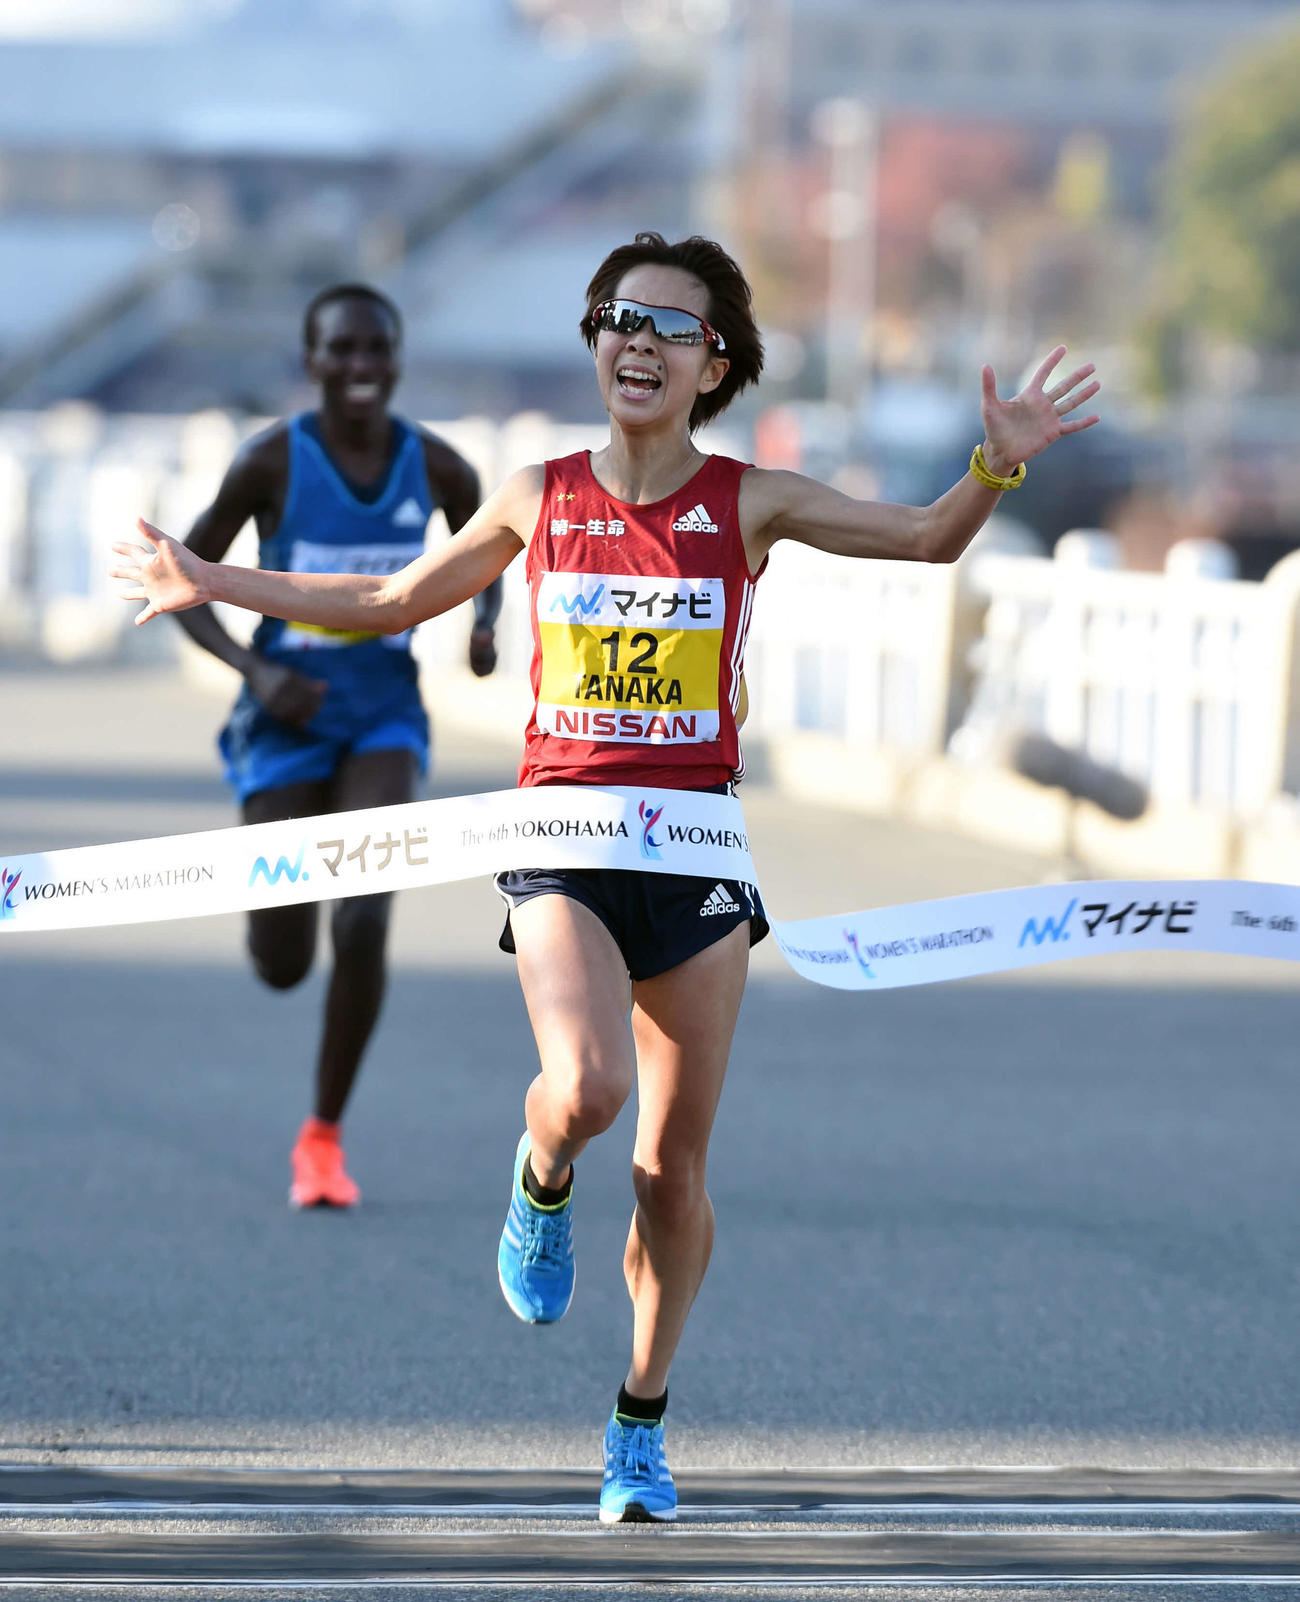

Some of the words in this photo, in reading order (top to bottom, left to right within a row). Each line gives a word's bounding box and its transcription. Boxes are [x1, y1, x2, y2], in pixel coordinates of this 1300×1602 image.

[550, 519, 626, 537] 第一生命
[672, 519, 719, 534] adidas
[611, 589, 712, 619] マイナビ
[600, 631, 659, 675] 12
[555, 710, 697, 739] NISSAN
[461, 829, 484, 848] The
[514, 820, 630, 839] YOKOHAMA
[667, 824, 749, 853] WOMEN'S
[316, 826, 429, 877] マイナビ
[24, 876, 109, 901] WOMEN'S
[114, 864, 214, 892] MARATHON
[700, 901, 741, 917] adidas
[1081, 900, 1198, 938] マイナビ
